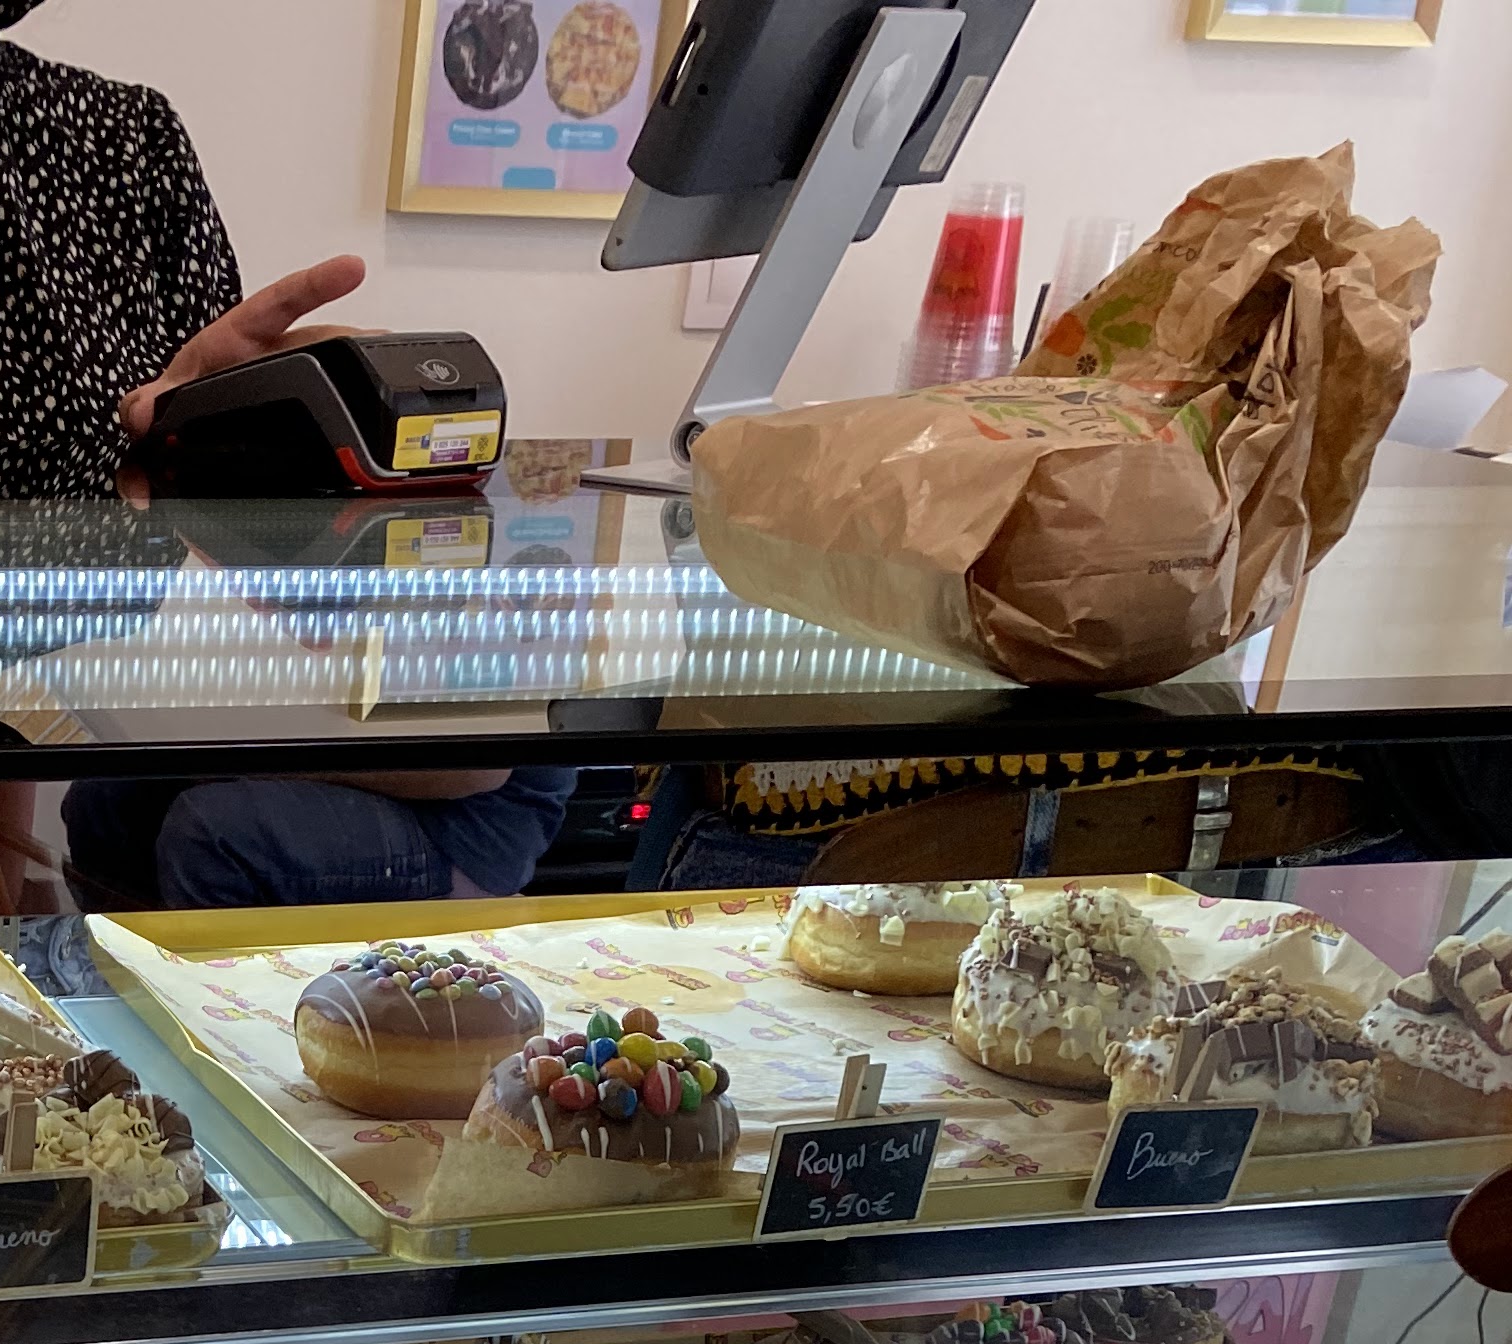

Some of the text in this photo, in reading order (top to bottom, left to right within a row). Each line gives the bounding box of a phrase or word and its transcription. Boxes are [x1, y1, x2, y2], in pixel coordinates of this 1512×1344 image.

[796, 1140, 866, 1189] Royal
[880, 1127, 927, 1162] Ball
[1126, 1131, 1214, 1181] Bueno
